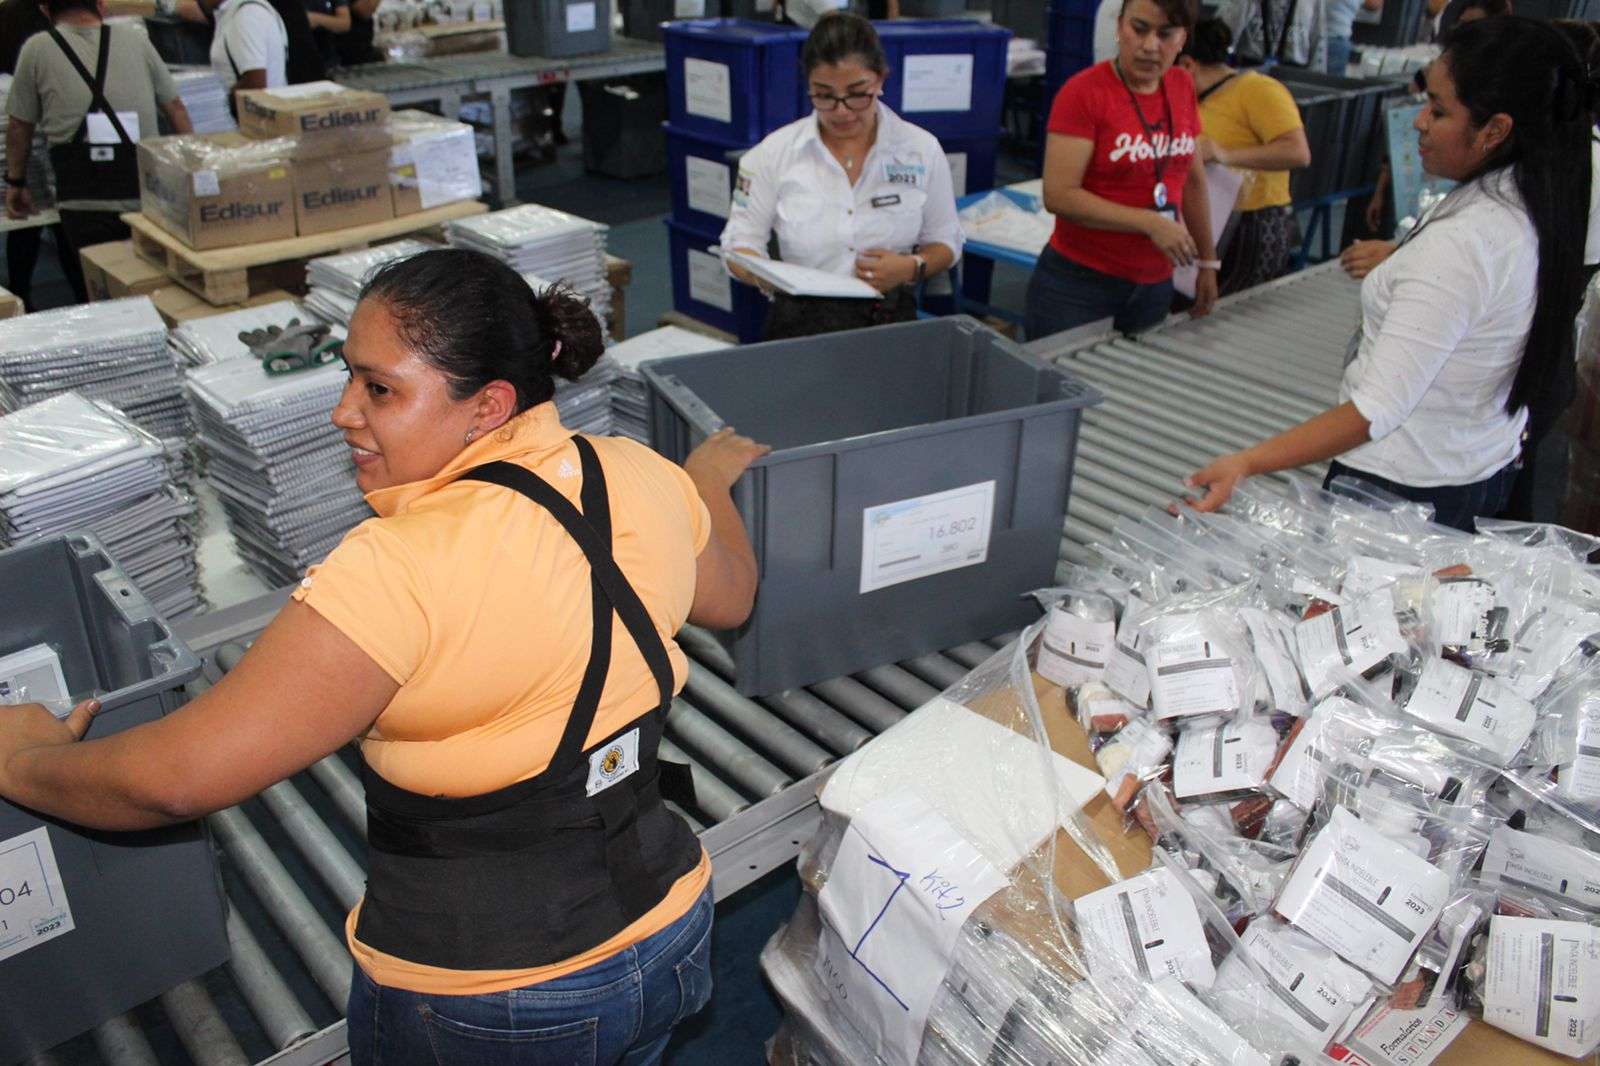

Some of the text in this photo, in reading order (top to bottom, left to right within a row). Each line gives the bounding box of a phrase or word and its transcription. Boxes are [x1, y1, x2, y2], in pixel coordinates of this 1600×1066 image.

[301, 107, 380, 131] Edisur
[303, 184, 380, 210] Edisur
[201, 202, 283, 223] Edisur
[929, 516, 976, 540] 16.802
[1404, 898, 1426, 915] 2023
[37, 921, 61, 936] 2023
[1316, 985, 1338, 1006] 2023
[1568, 1017, 1578, 1039] 2023
